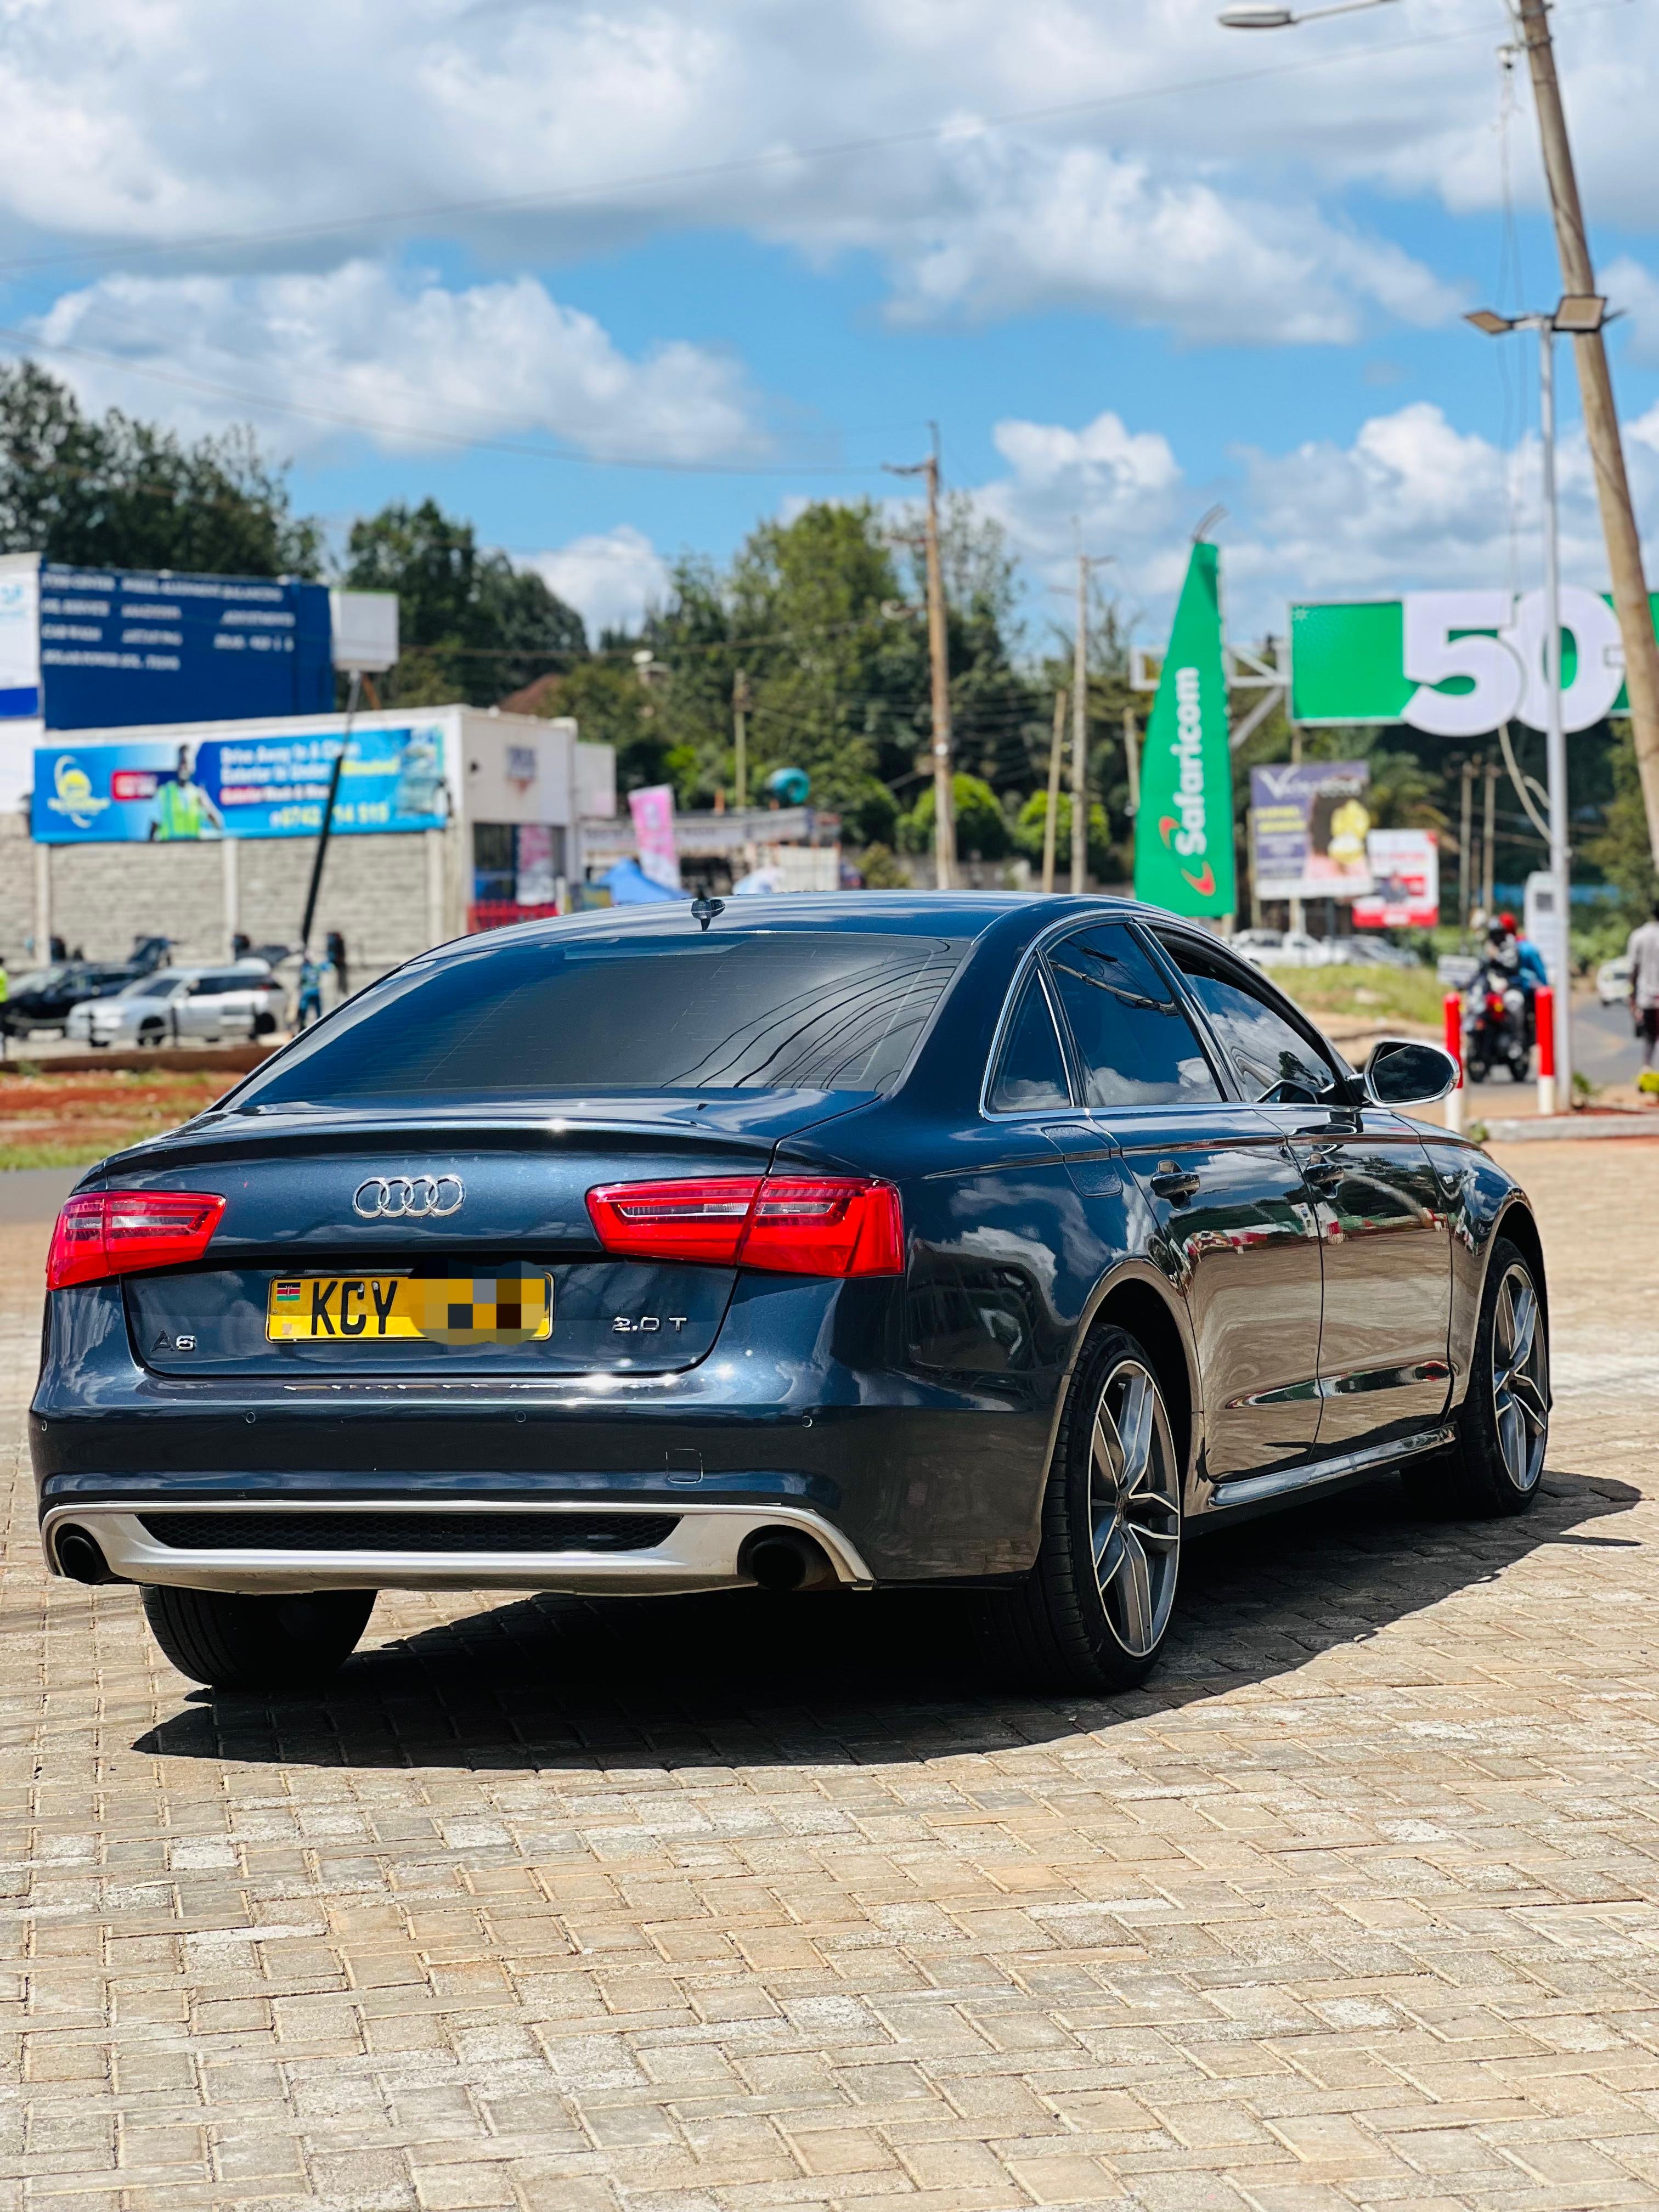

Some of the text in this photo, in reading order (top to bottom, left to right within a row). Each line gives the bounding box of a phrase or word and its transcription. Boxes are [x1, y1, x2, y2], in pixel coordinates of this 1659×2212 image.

[1400, 585, 1626, 737] 50
[1170, 667, 1207, 856] Safaricom
[311, 1281, 398, 1335] KCY
[612, 1316, 687, 1331] 2.0 T
[150, 1330, 197, 1352] A6
